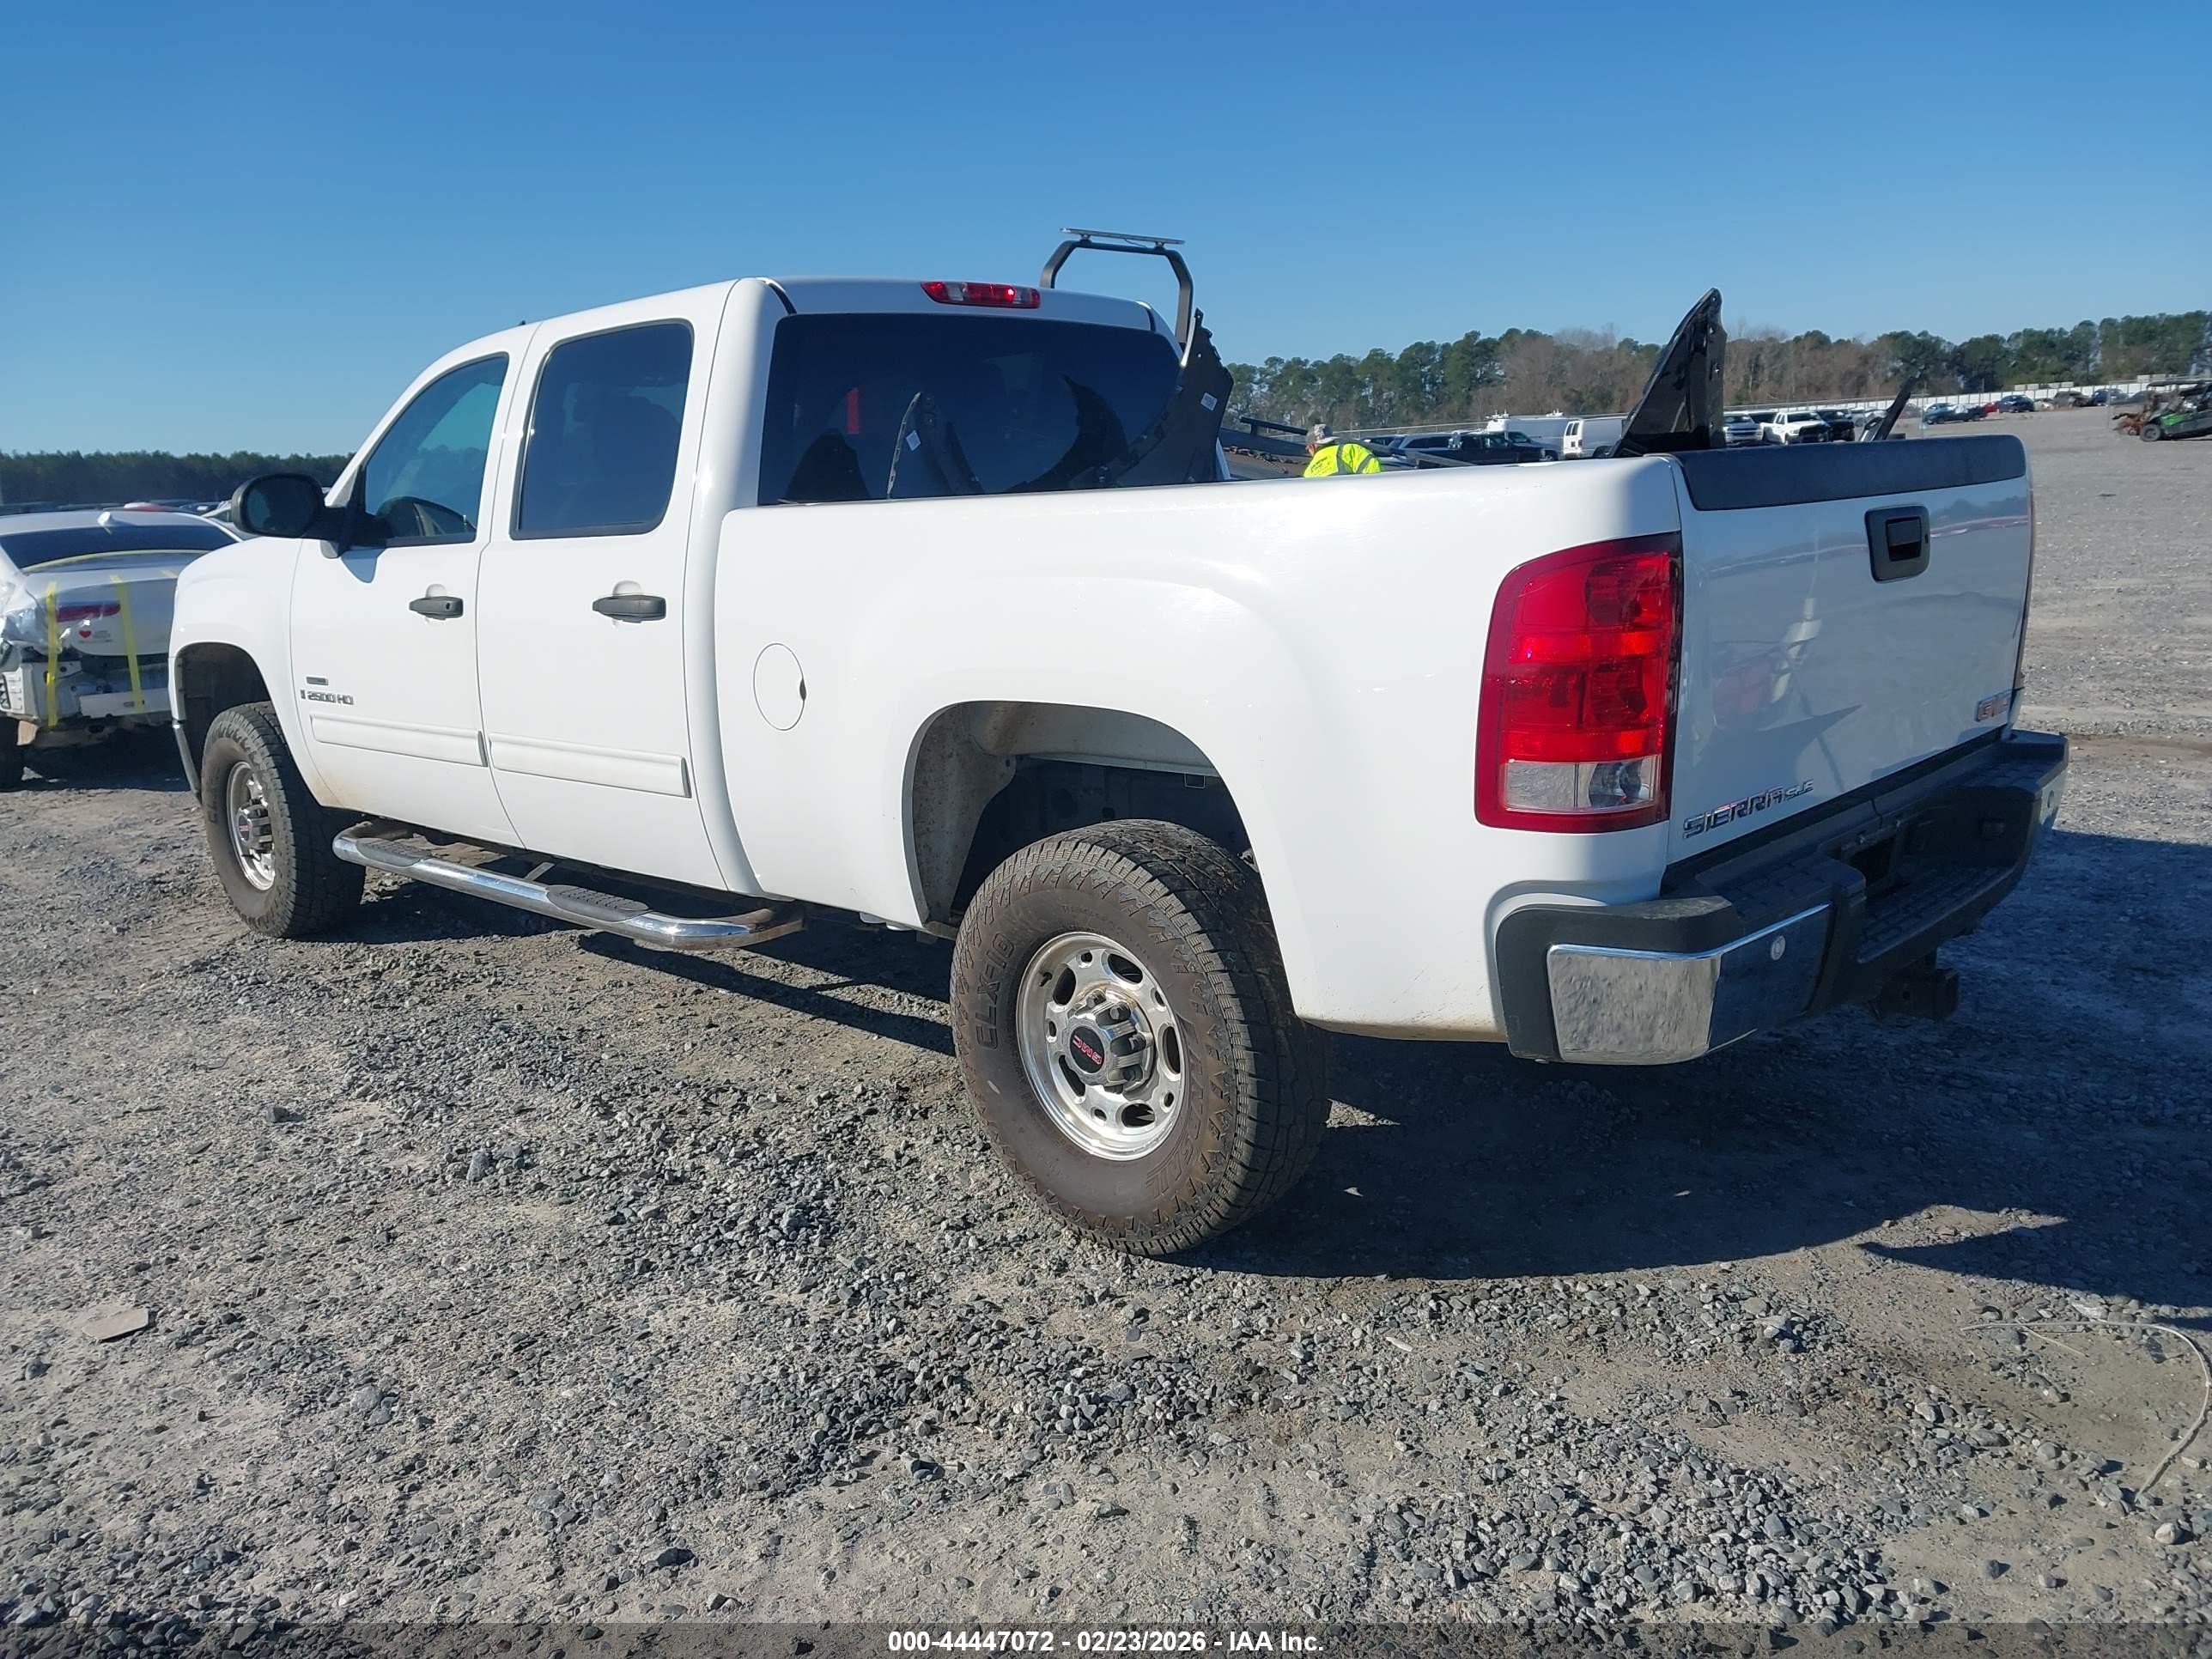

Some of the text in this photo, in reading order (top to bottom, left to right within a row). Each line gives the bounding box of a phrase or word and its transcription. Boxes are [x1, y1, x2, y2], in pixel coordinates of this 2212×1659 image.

[1683, 778, 1814, 839] SIERRA SLE
[1073, 1034, 1103, 1065] GMC
